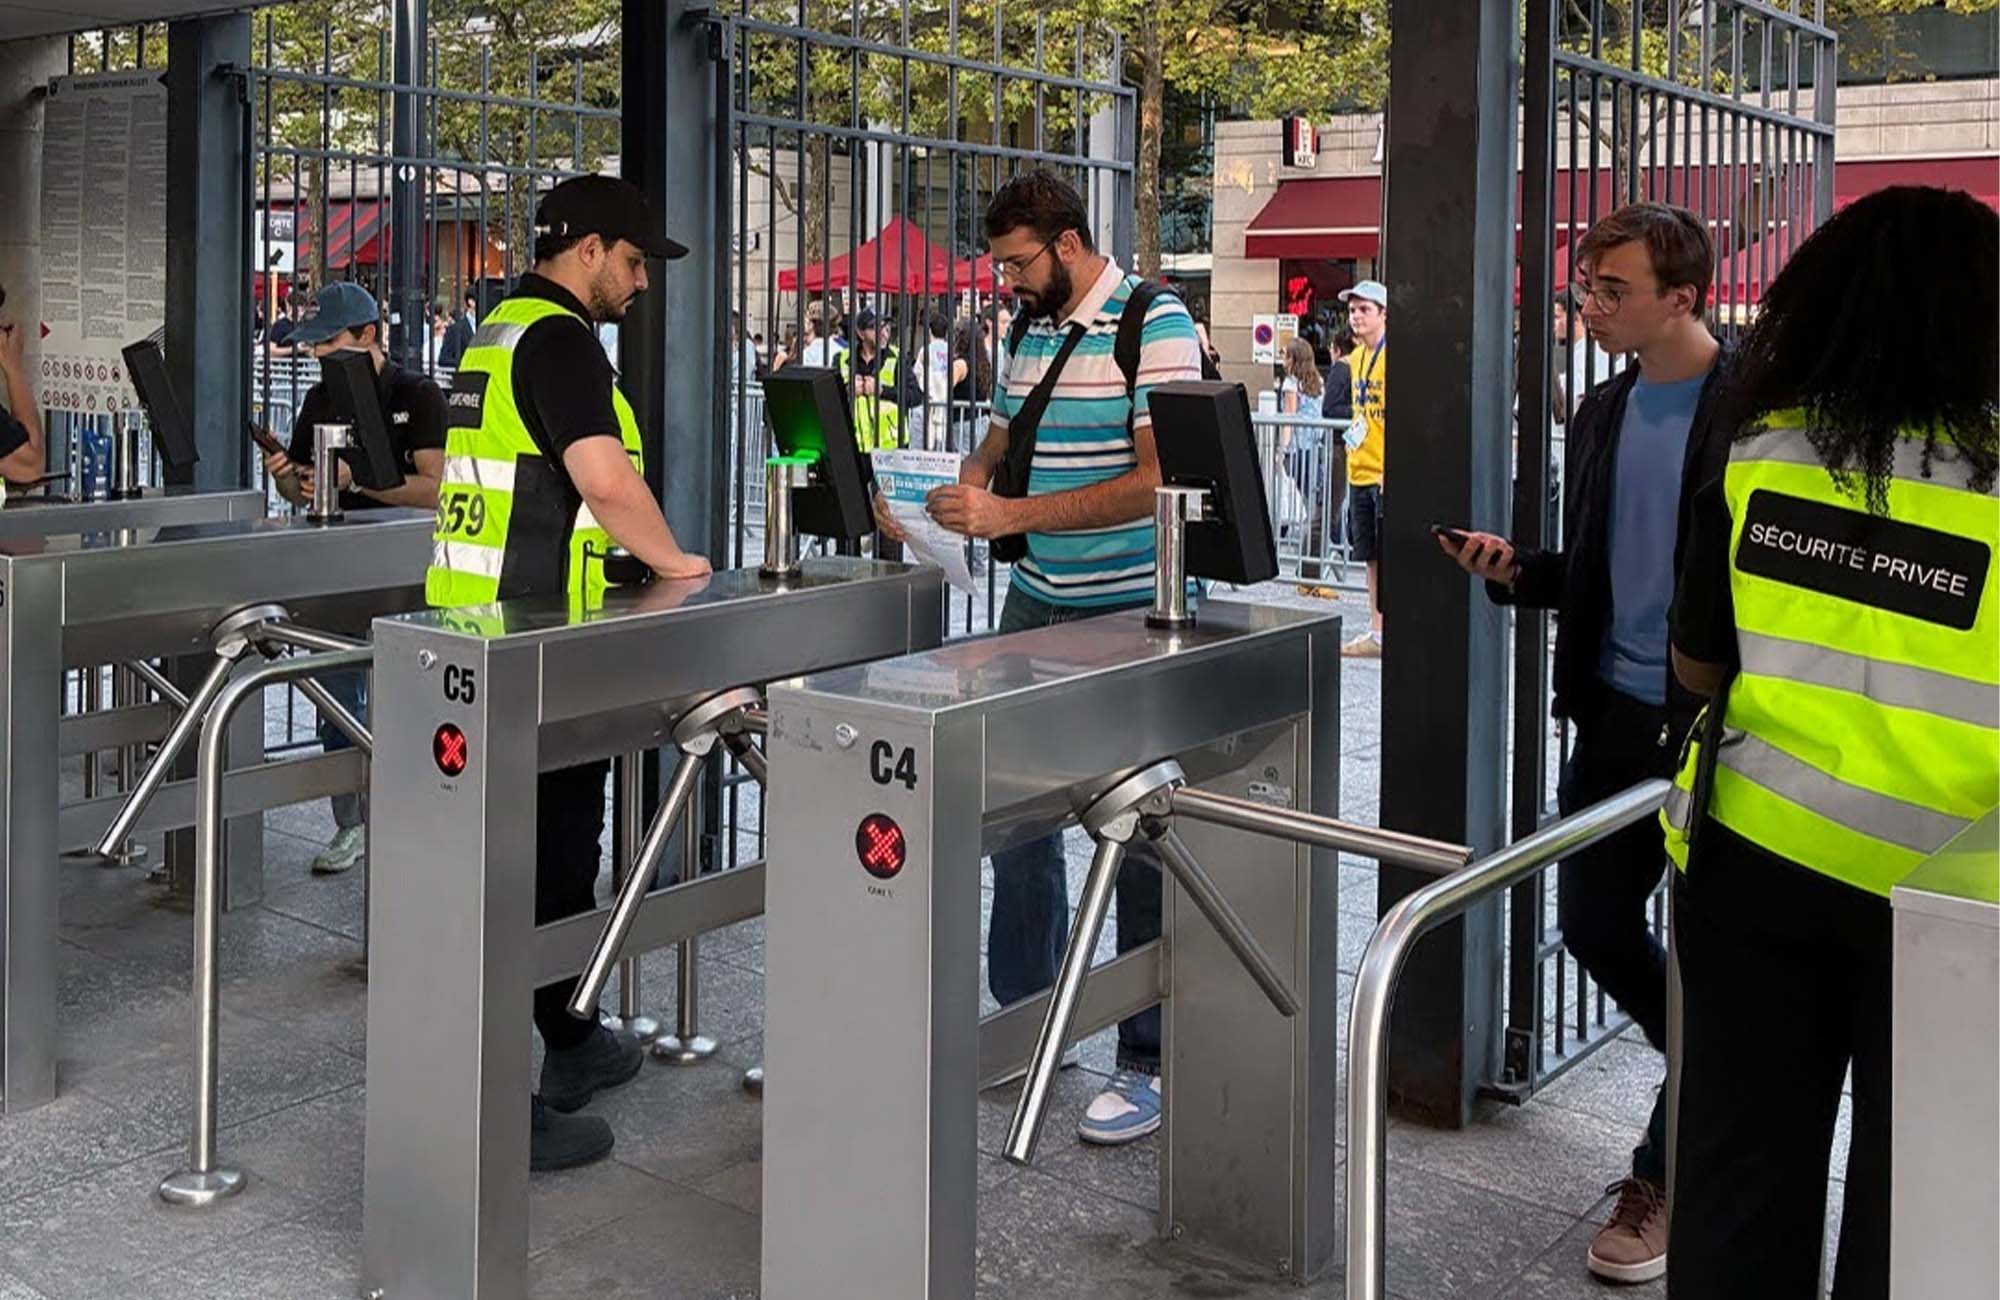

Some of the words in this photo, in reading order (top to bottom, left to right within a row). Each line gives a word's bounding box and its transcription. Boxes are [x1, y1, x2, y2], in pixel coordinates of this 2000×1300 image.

[1750, 523, 1867, 570] SÉCURITÉ
[1872, 554, 1968, 597] PRIVÉE
[443, 663, 476, 705] C5
[869, 739, 918, 791] C4
